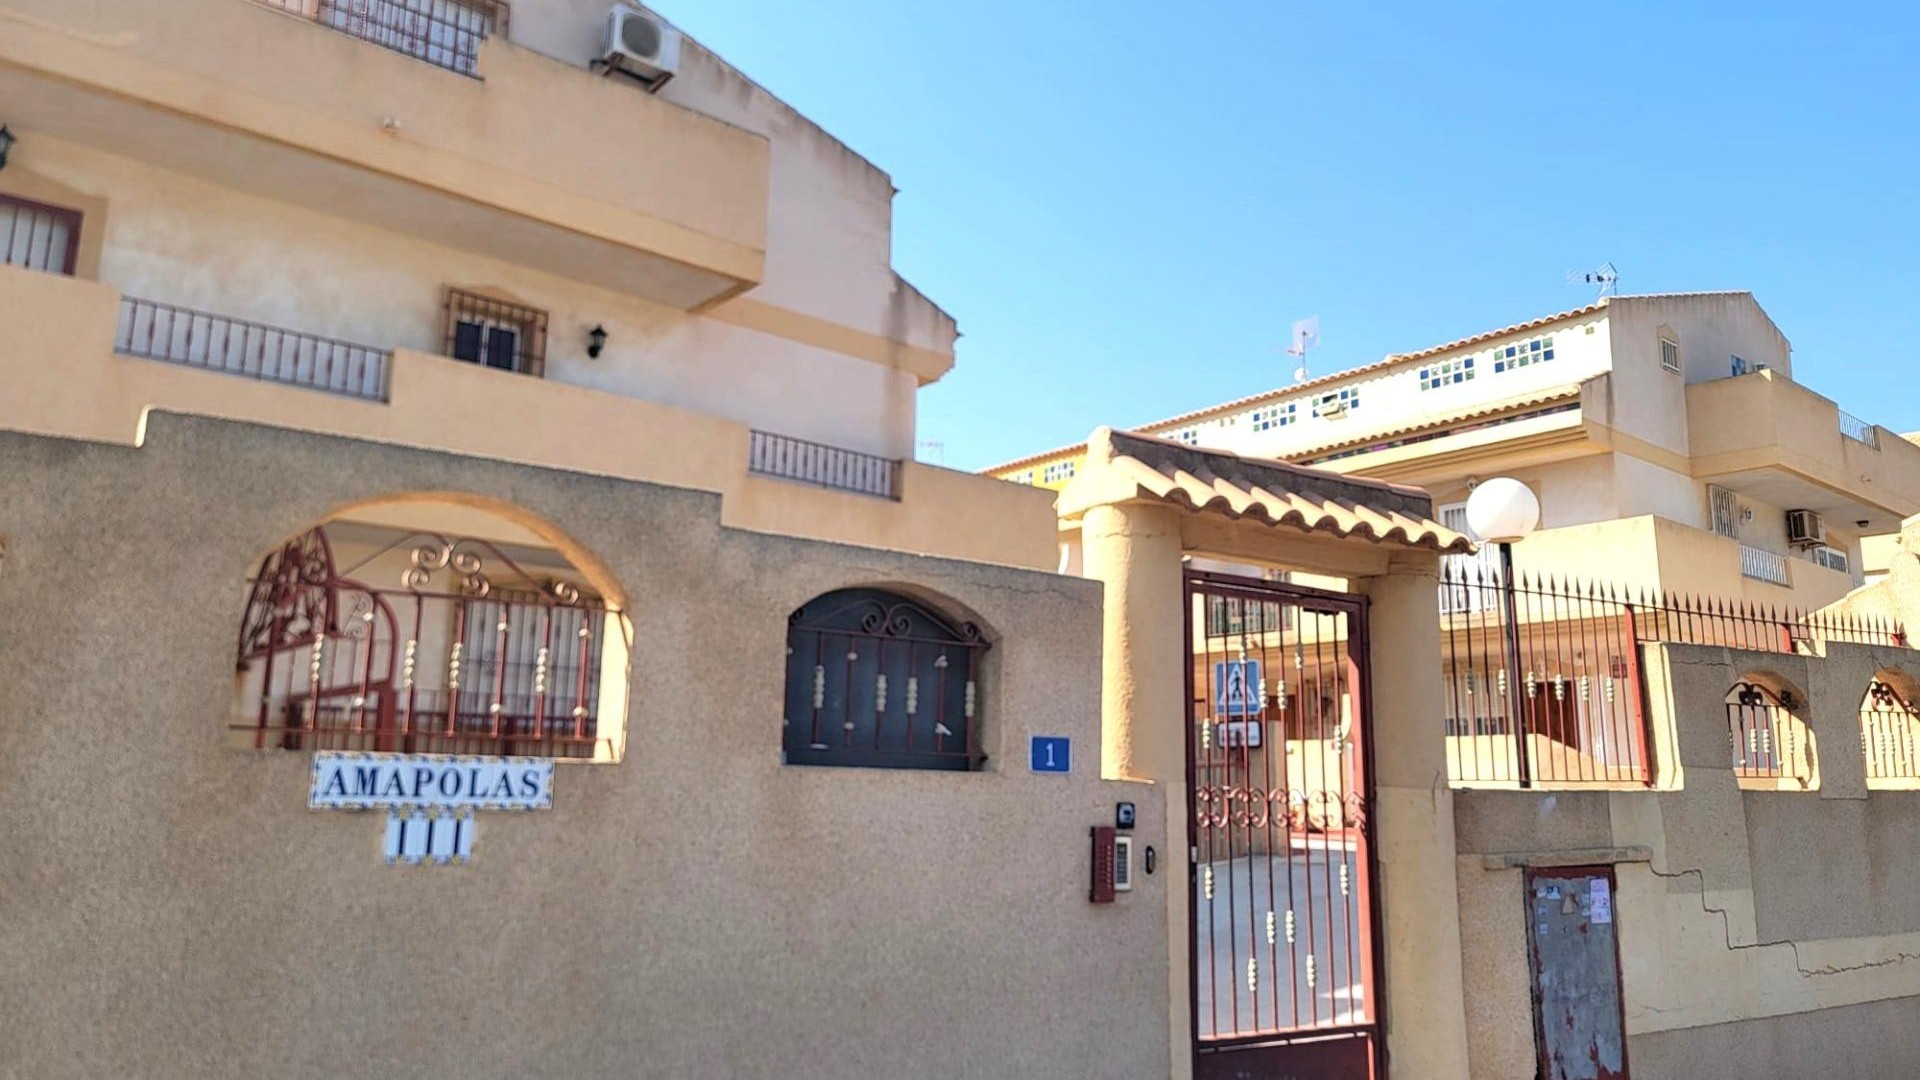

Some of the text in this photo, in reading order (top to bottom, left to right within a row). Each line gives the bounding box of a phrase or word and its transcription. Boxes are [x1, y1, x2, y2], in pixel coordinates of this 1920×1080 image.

[1046, 743, 1055, 767] 1
[323, 765, 541, 798] AMAPOLAS
[398, 819, 461, 855] III
